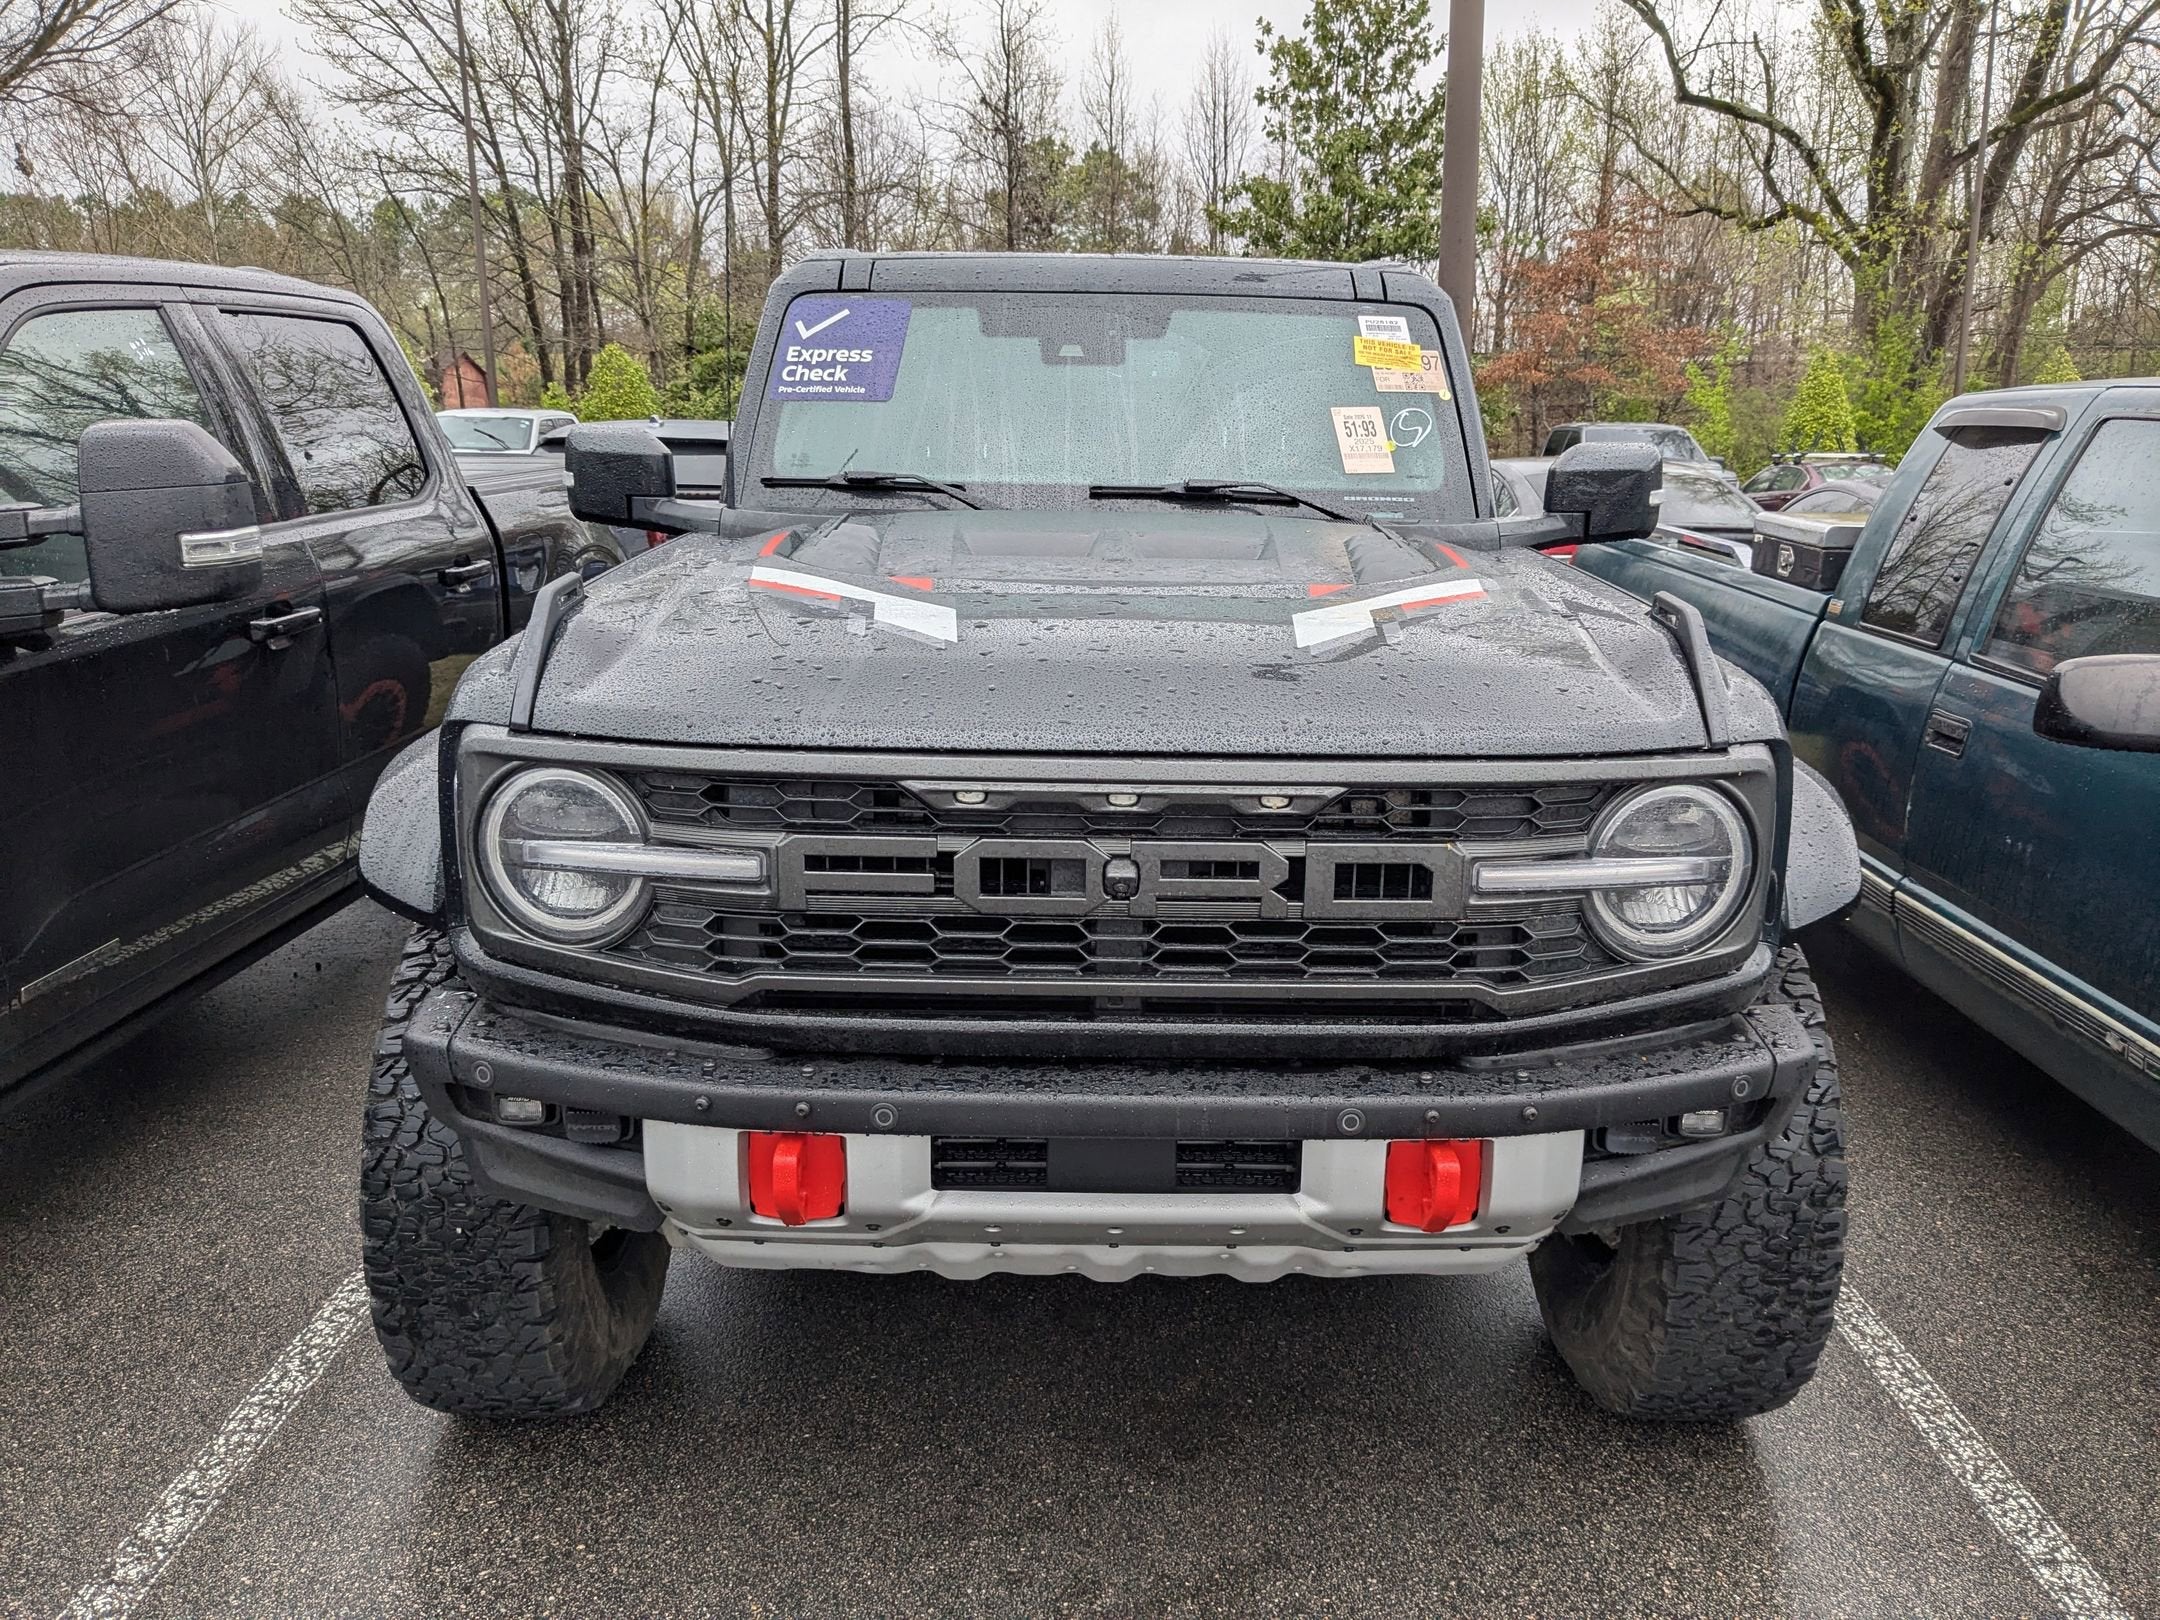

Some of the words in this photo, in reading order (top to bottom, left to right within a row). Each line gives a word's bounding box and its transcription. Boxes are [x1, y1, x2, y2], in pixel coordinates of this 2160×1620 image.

[1377, 340, 1408, 350] VEHICLE
[786, 346, 873, 364] Express
[781, 365, 849, 382] Check
[778, 385, 832, 393] Pre-Certified
[835, 385, 866, 394] Vehicle
[1343, 420, 1377, 437] 51:93
